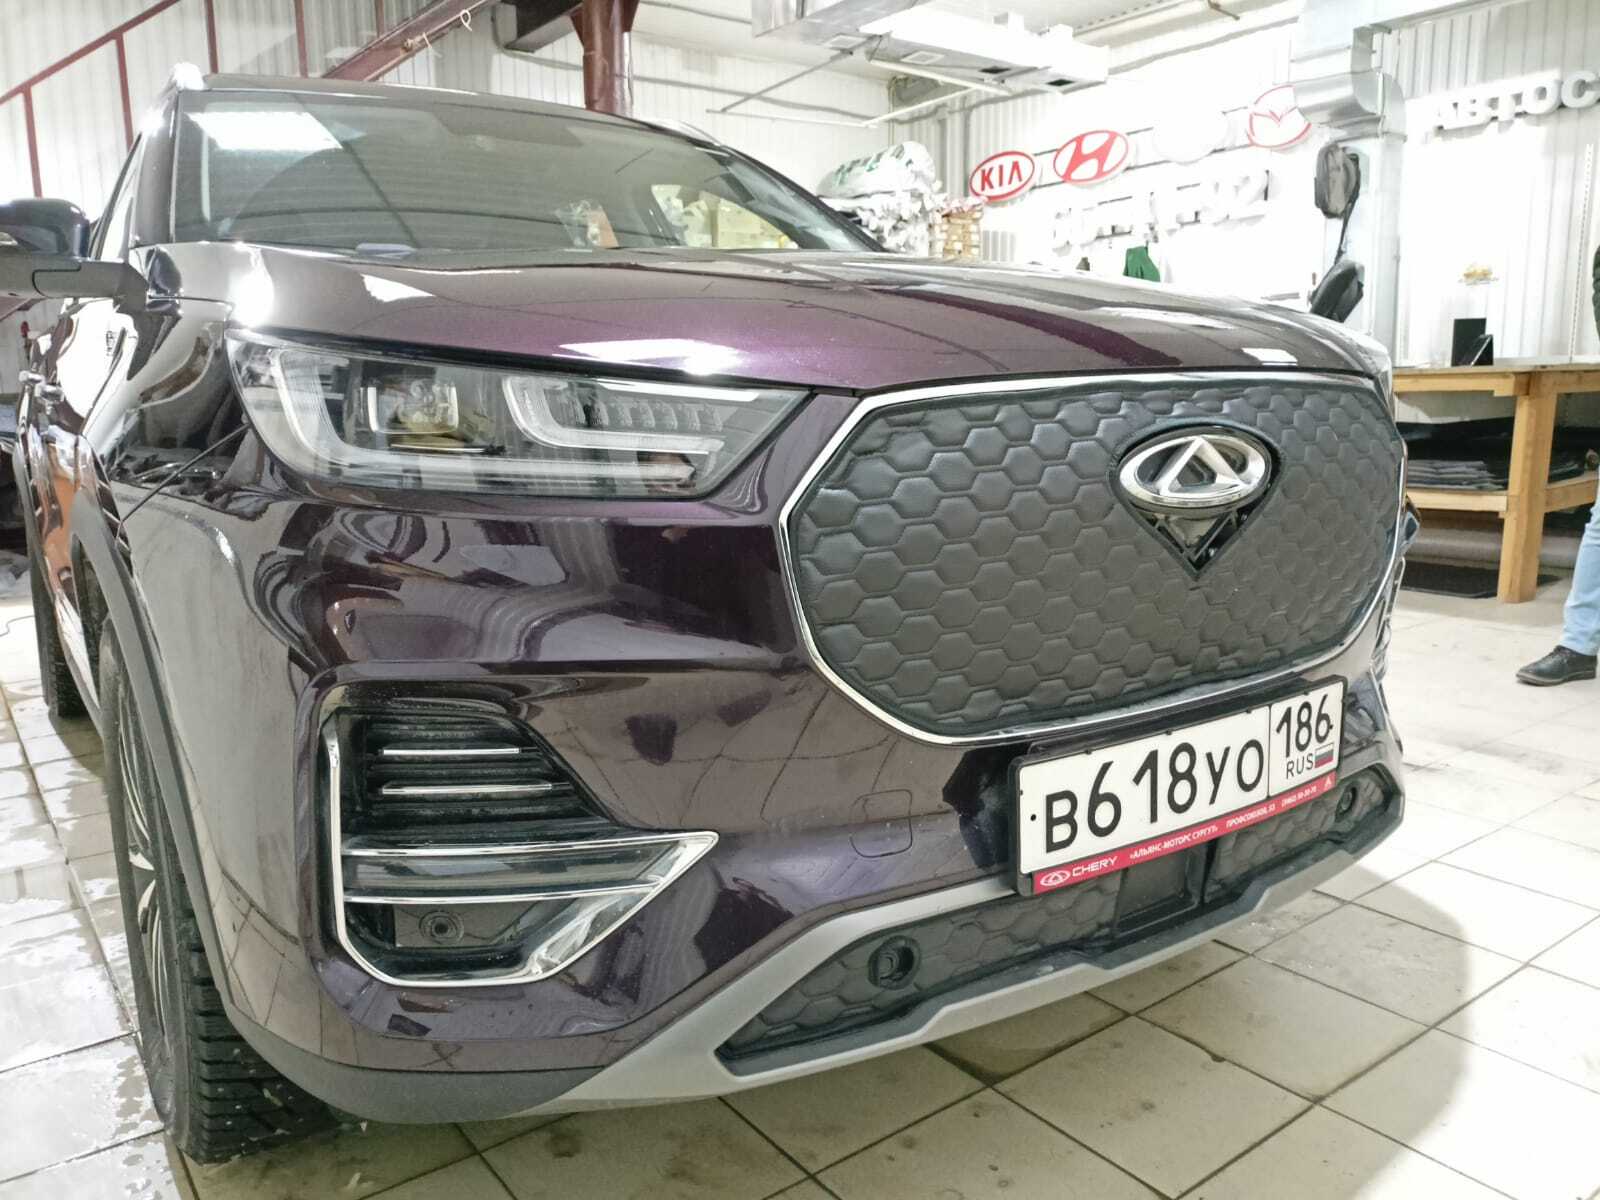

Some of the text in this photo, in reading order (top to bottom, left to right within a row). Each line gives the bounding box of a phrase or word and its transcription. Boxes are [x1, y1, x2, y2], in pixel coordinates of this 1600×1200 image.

[980, 160, 1022, 191] KIA
[1276, 694, 1331, 758] 186
[1286, 752, 1314, 779] RUS
[1046, 739, 1265, 854] В618УО
[1072, 856, 1118, 877] CHERY
